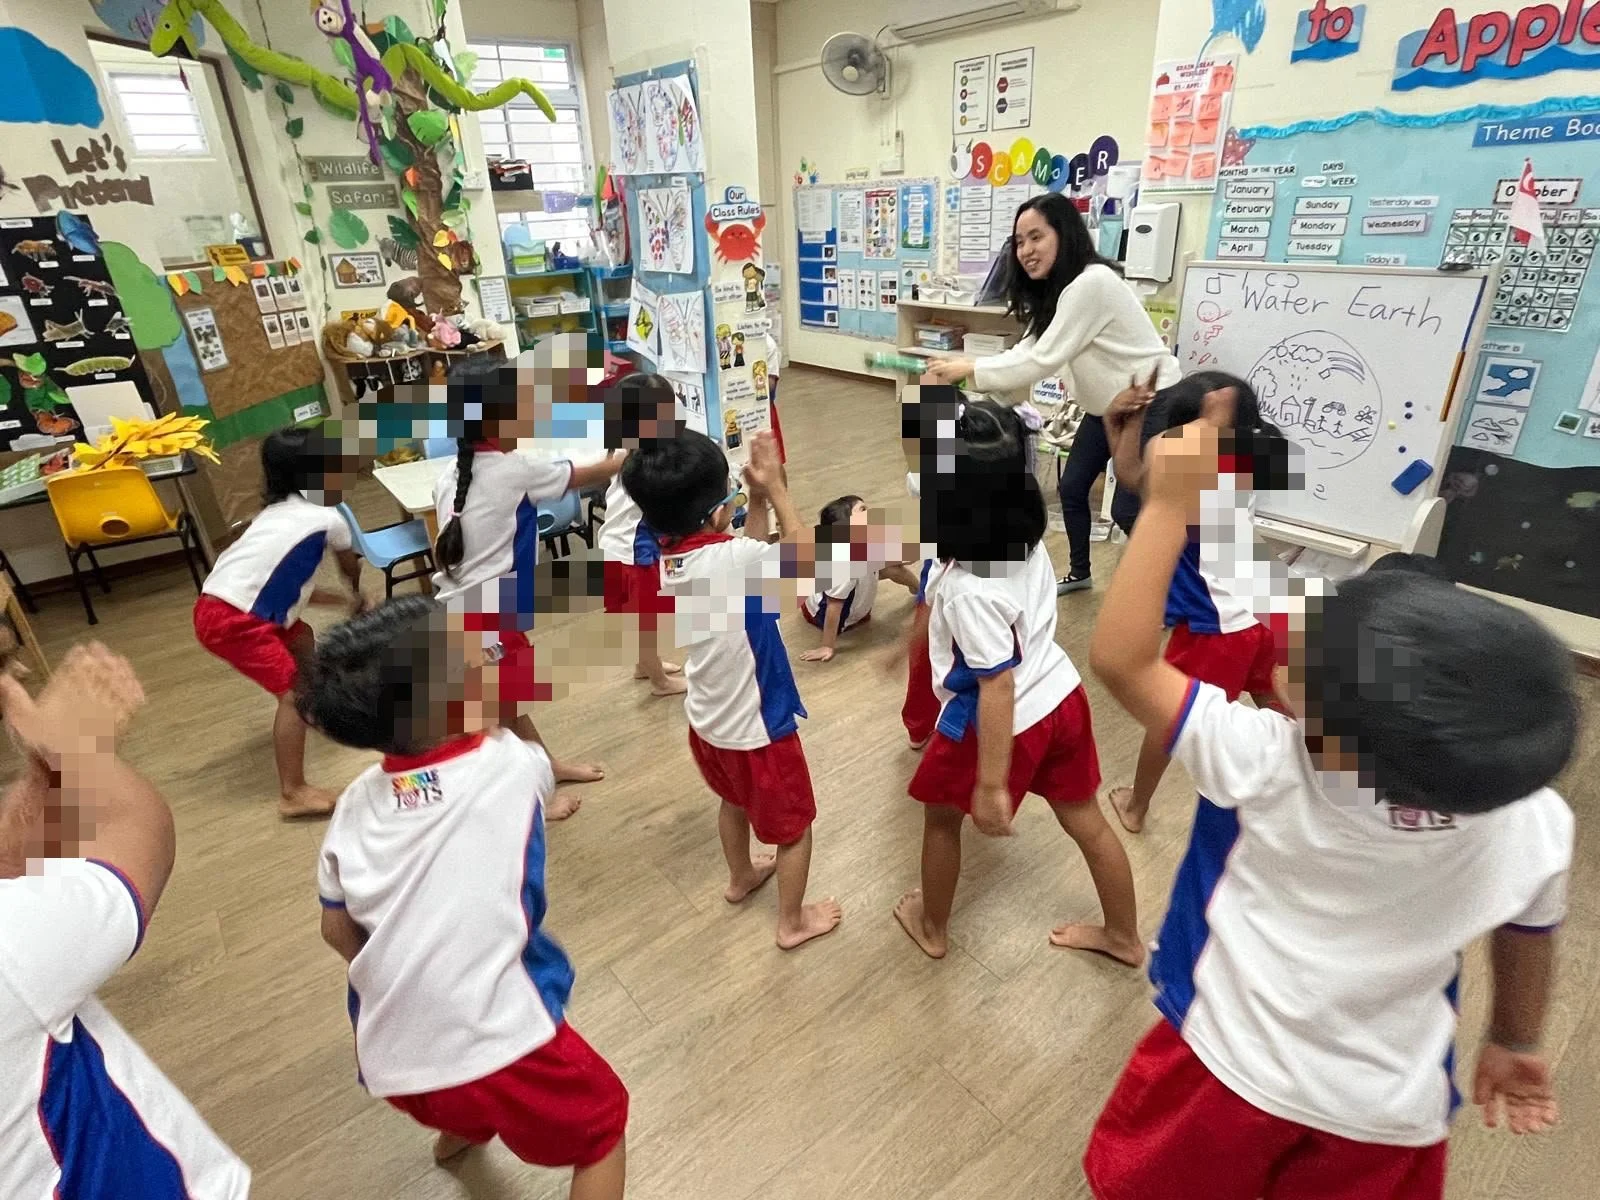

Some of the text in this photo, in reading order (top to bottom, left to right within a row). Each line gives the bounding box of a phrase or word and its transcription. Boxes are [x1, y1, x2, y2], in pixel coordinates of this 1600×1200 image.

[1308, 0, 1353, 43] to
[1483, 125, 1553, 141] Theme
[51, 133, 127, 175] Let's
[319, 160, 379, 176] Wildlife
[1220, 168, 1248, 177] MONTHS
[1273, 165, 1295, 175] YEAR
[1322, 162, 1344, 171] DAYS
[1331, 177, 1355, 185] WEEK
[729, 190, 744, 200] Our
[1231, 184, 1269, 195] January
[1505, 185, 1567, 197] Oober
[331, 190, 384, 204] Safari
[1225, 204, 1271, 215] February
[1305, 201, 1339, 210] Sunday
[712, 205, 760, 218] Class Rules
[1230, 224, 1260, 234] March
[1300, 221, 1336, 231] Monday
[1366, 219, 1421, 229] Wednesday
[1230, 243, 1254, 253] April
[1295, 242, 1333, 251] Tuesday
[1244, 286, 1442, 335] Water Earth
